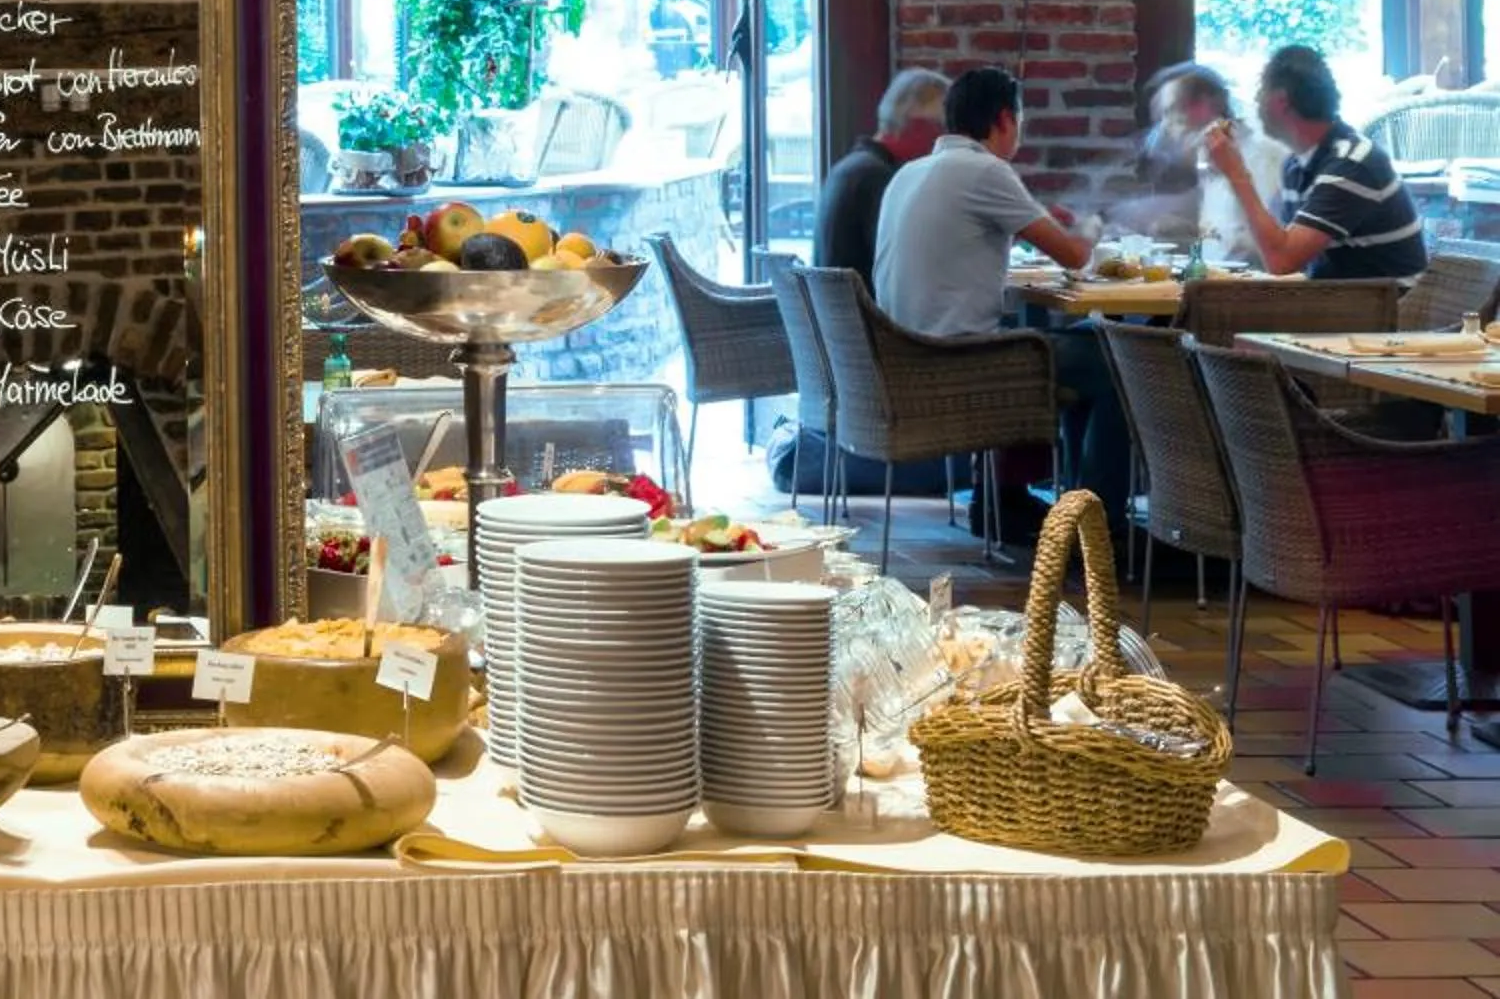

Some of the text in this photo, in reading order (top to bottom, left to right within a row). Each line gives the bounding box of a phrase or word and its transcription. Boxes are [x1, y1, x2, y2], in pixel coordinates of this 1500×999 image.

[57, 71, 103, 97] von
[107, 47, 197, 92] Hercules
[47, 131, 96, 154] von
